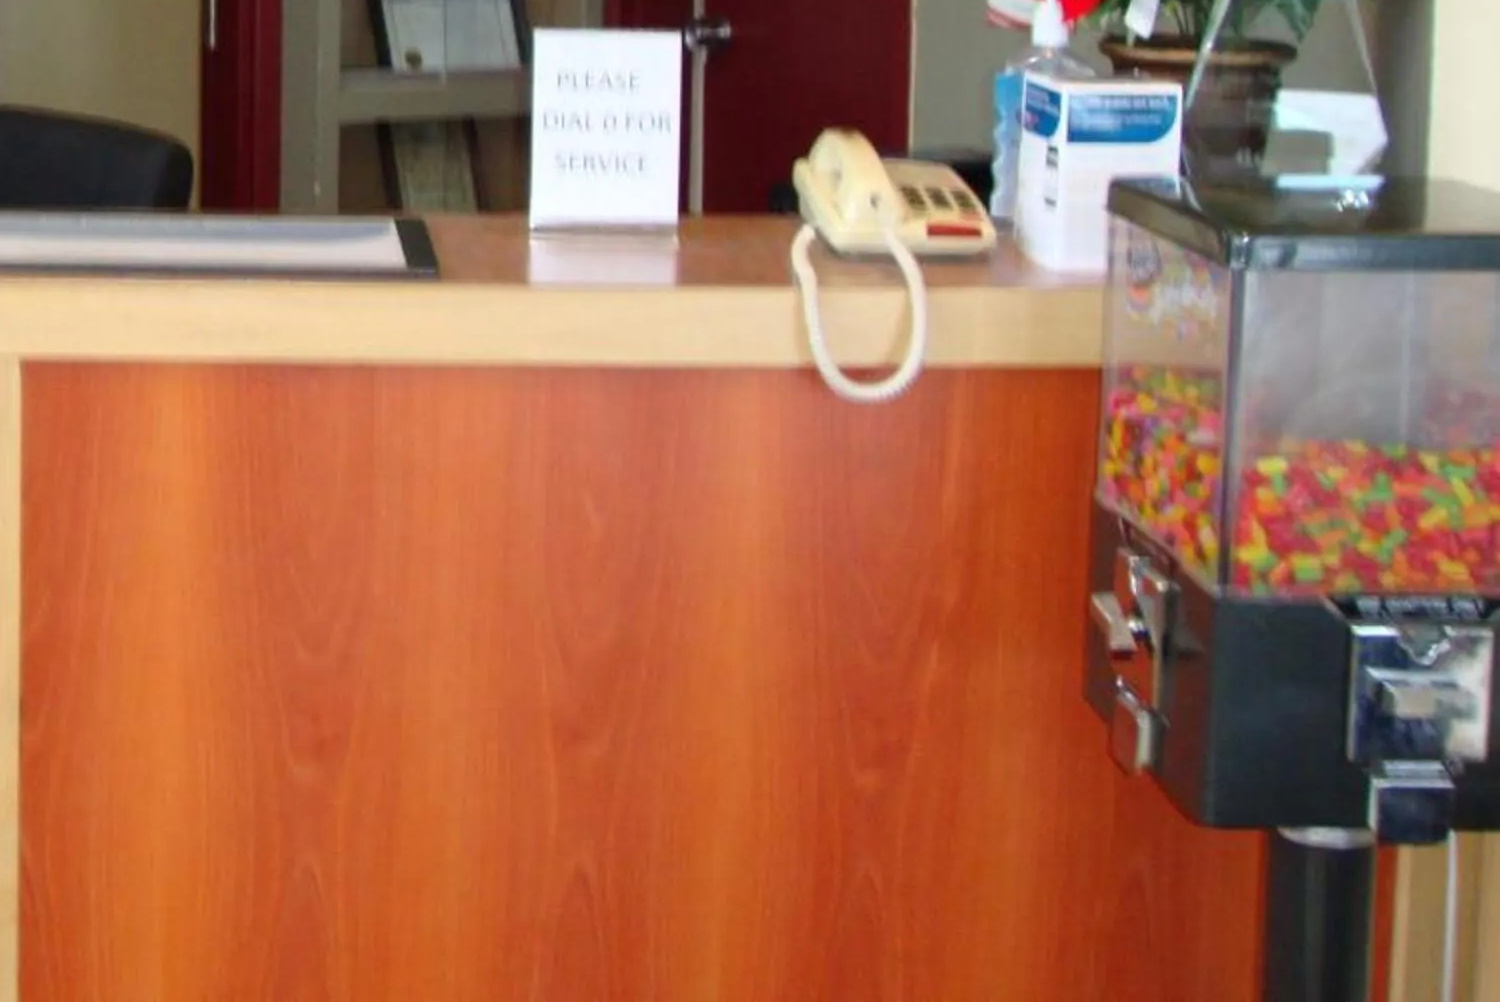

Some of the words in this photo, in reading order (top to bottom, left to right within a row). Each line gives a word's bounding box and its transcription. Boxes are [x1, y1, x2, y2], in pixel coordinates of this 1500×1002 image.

[556, 69, 642, 94] PLEASE
[542, 110, 595, 133] DIAL
[624, 111, 672, 135] FOR
[554, 150, 647, 175] SERVICE
